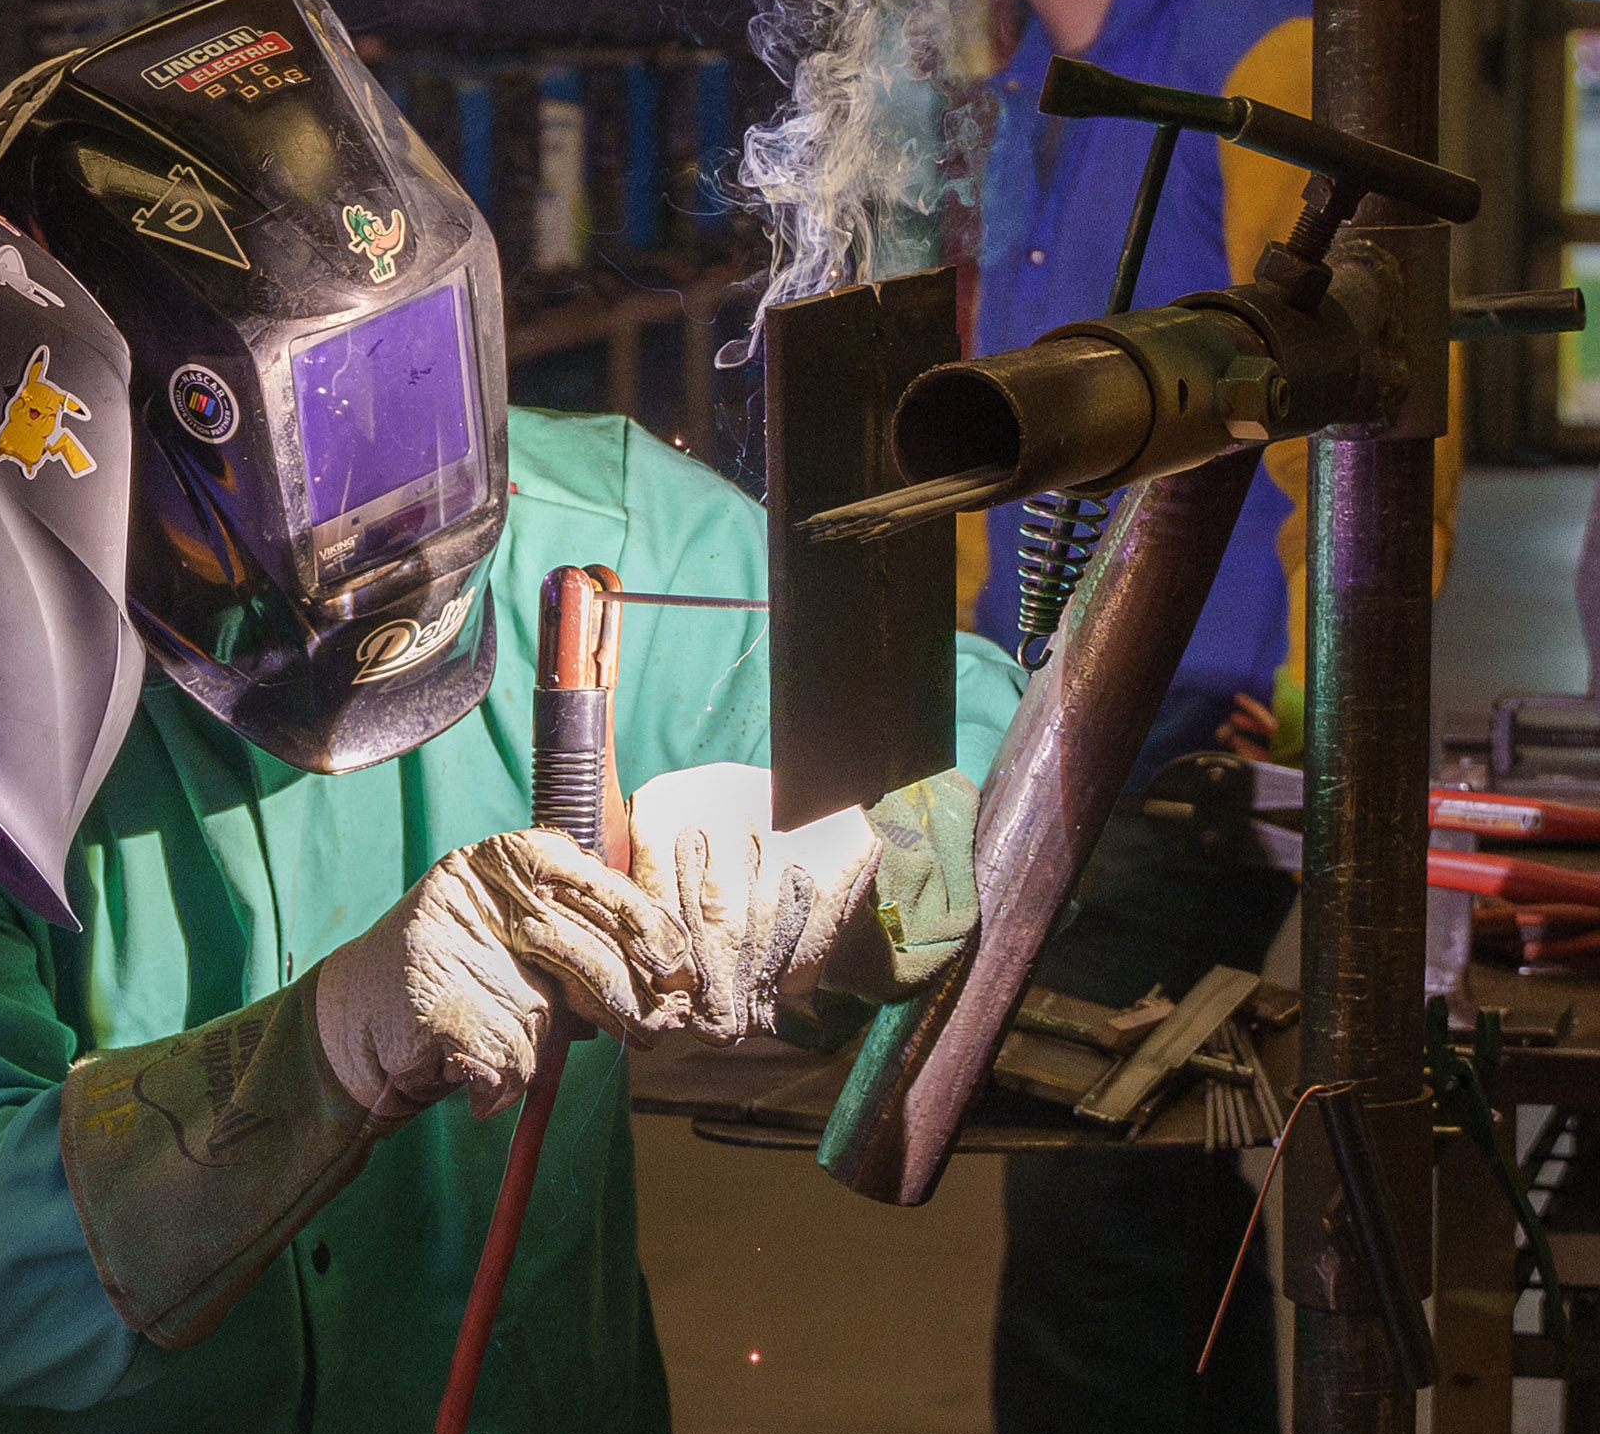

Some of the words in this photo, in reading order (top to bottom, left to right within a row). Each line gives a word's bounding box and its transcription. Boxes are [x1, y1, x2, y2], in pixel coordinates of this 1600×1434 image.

[150, 30, 257, 84] LINCOLN
[190, 40, 279, 83] ELECTRIC
[204, 62, 270, 99] BIG
[239, 68, 304, 99] DOG
[180, 372, 226, 399] NASCAR
[318, 535, 357, 561] VIKING
